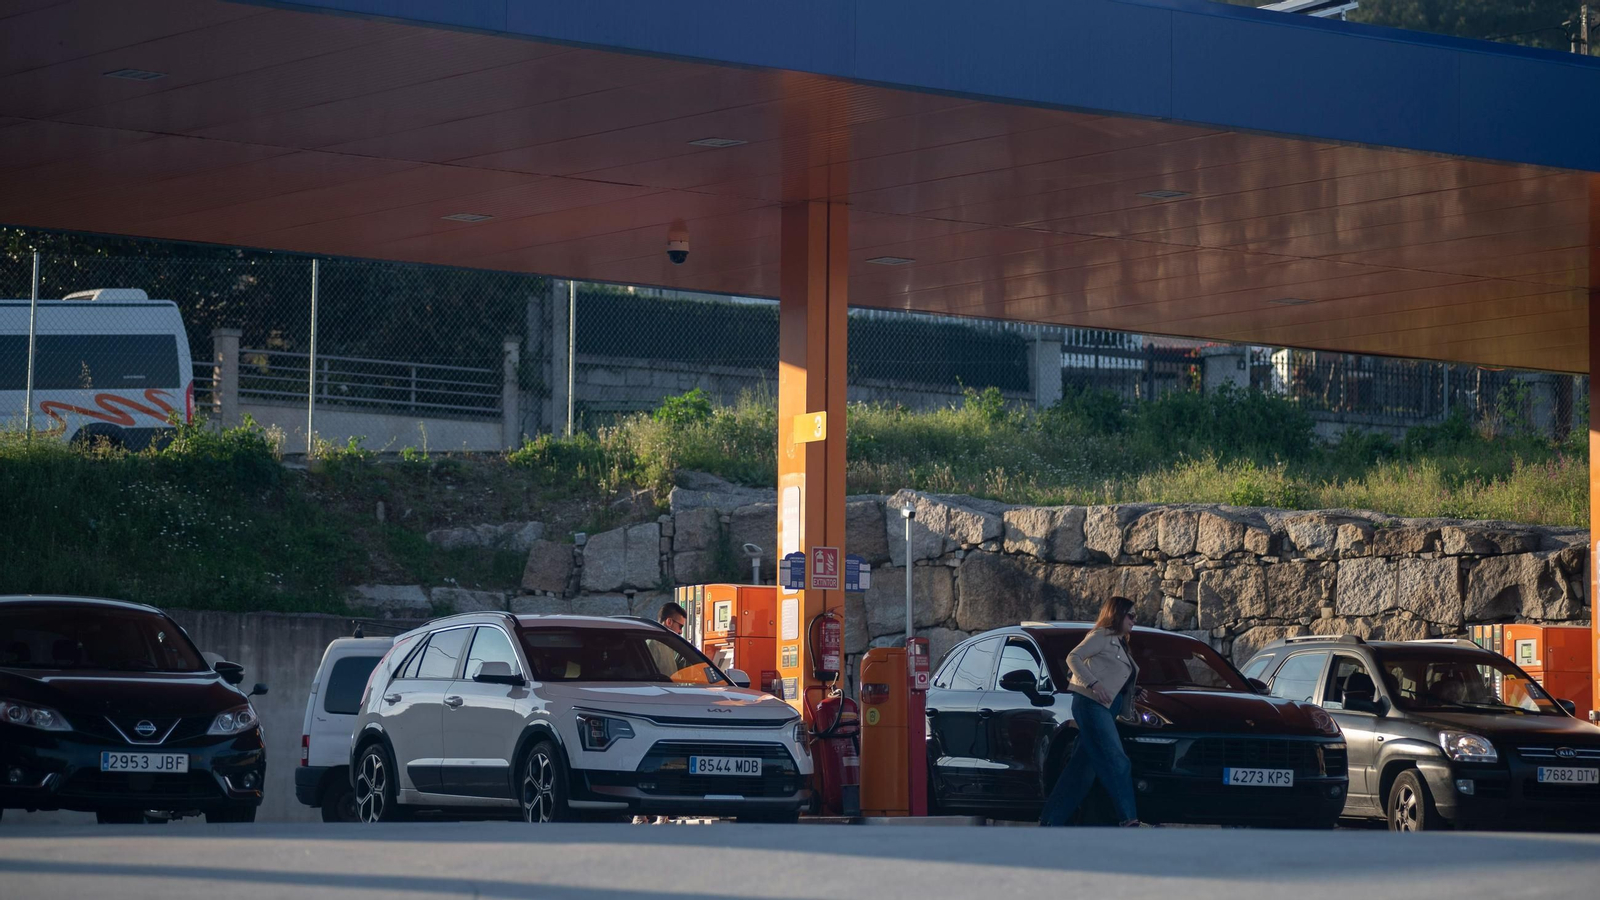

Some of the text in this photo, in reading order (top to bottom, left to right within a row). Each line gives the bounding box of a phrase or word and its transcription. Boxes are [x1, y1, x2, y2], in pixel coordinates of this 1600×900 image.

[814, 415, 822, 438] 3
[813, 578, 837, 587] EXTINTOR
[109, 754, 185, 770] 2953 JBF
[699, 758, 759, 773] 8544 MDB
[1232, 770, 1291, 784] 4273 KPS
[1546, 768, 1596, 782] 7682 DTV
